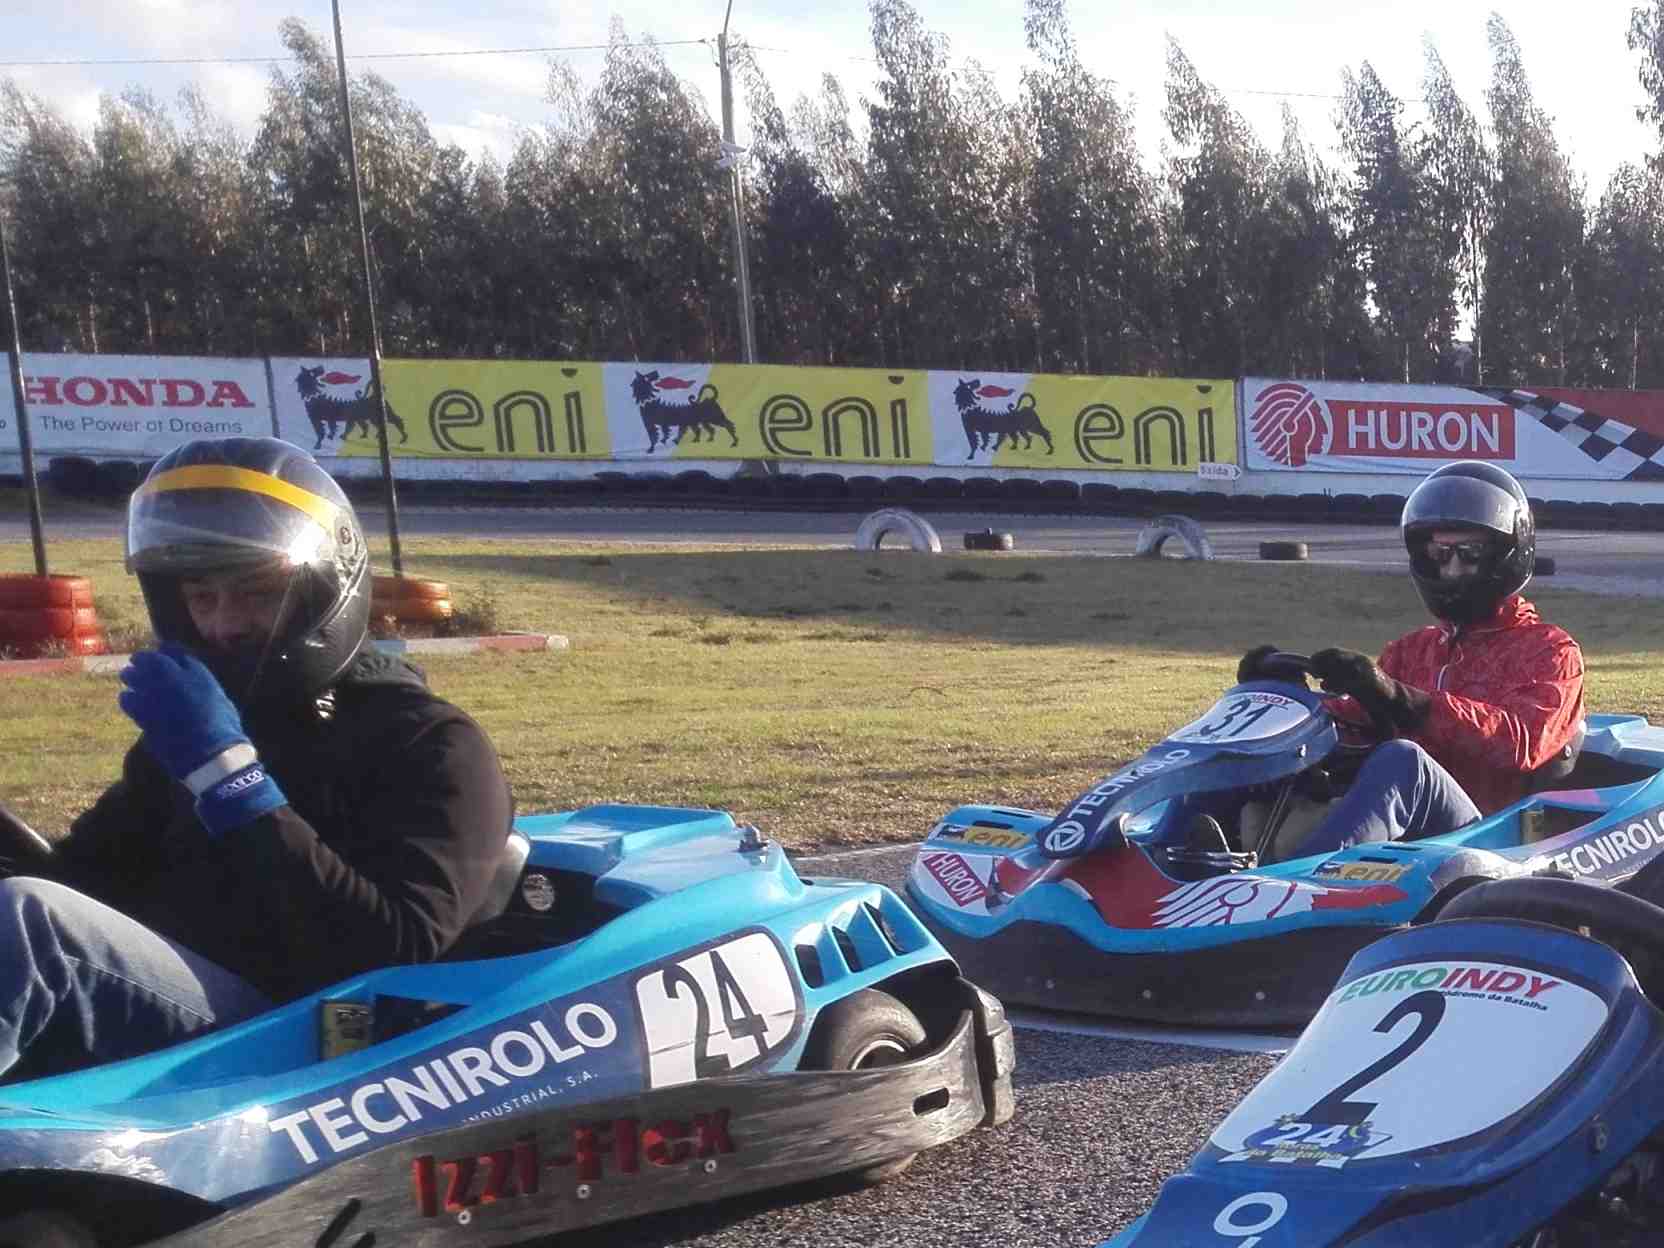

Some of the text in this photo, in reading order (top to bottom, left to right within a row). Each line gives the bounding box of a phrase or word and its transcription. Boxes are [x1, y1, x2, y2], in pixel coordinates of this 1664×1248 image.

[25, 376, 256, 408] HONDA
[428, 368, 587, 454] eni
[40, 416, 243, 434] The Power of Dreams
[760, 375, 911, 458] eni
[1074, 384, 1216, 466] eni
[1347, 410, 1502, 452] HURON
[1200, 699, 1274, 737] 31
[933, 854, 983, 902] HURON
[1337, 967, 1562, 1006] EUROINDY
[1504, 995, 1549, 1012] Batalha
[661, 950, 769, 1079] 24
[1298, 989, 1447, 1125] 2
[269, 1002, 617, 1164] TECNIROLO
[567, 1070, 599, 1088] S.A.
[1261, 1122, 1350, 1148] 24
